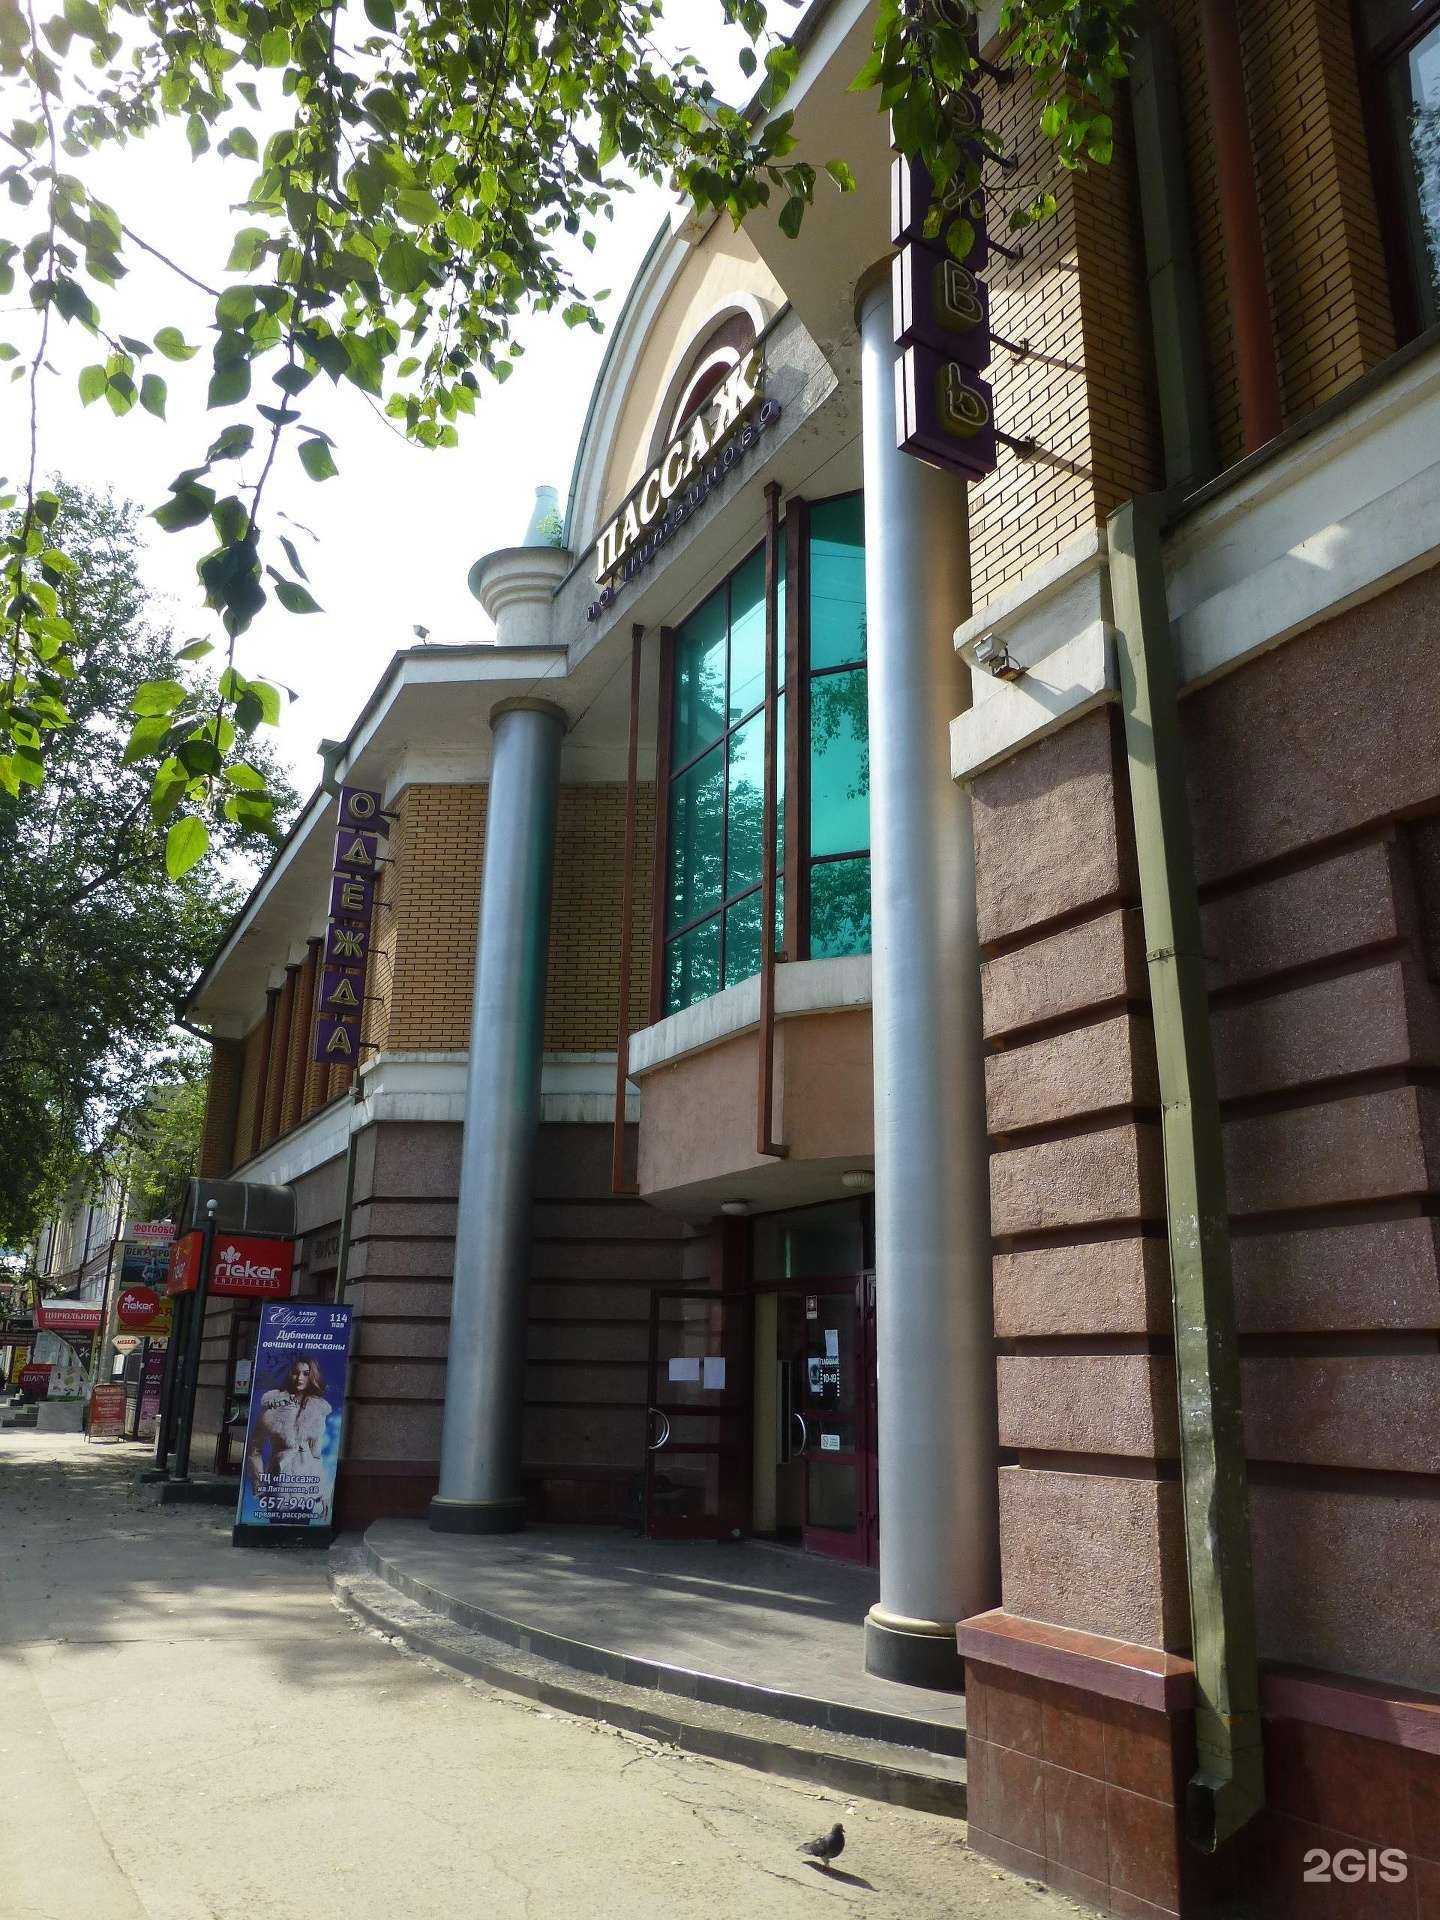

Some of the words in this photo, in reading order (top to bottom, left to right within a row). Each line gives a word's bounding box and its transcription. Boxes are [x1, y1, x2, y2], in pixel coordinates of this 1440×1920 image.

[596, 347, 764, 583] ПАССАЖ
[327, 792, 375, 1056] ОДЕЖДА
[215, 1260, 282, 1279] rieker
[122, 1300, 155, 1310] rieker
[330, 1313, 348, 1323] 114
[277, 1330, 321, 1340] Дубленки
[262, 1341, 295, 1349] овчины
[305, 1343, 346, 1351] тосканы
[259, 1473, 271, 1484] ТЦ
[273, 1473, 320, 1484] «Пассаж»
[259, 1496, 315, 1510] 657-940
